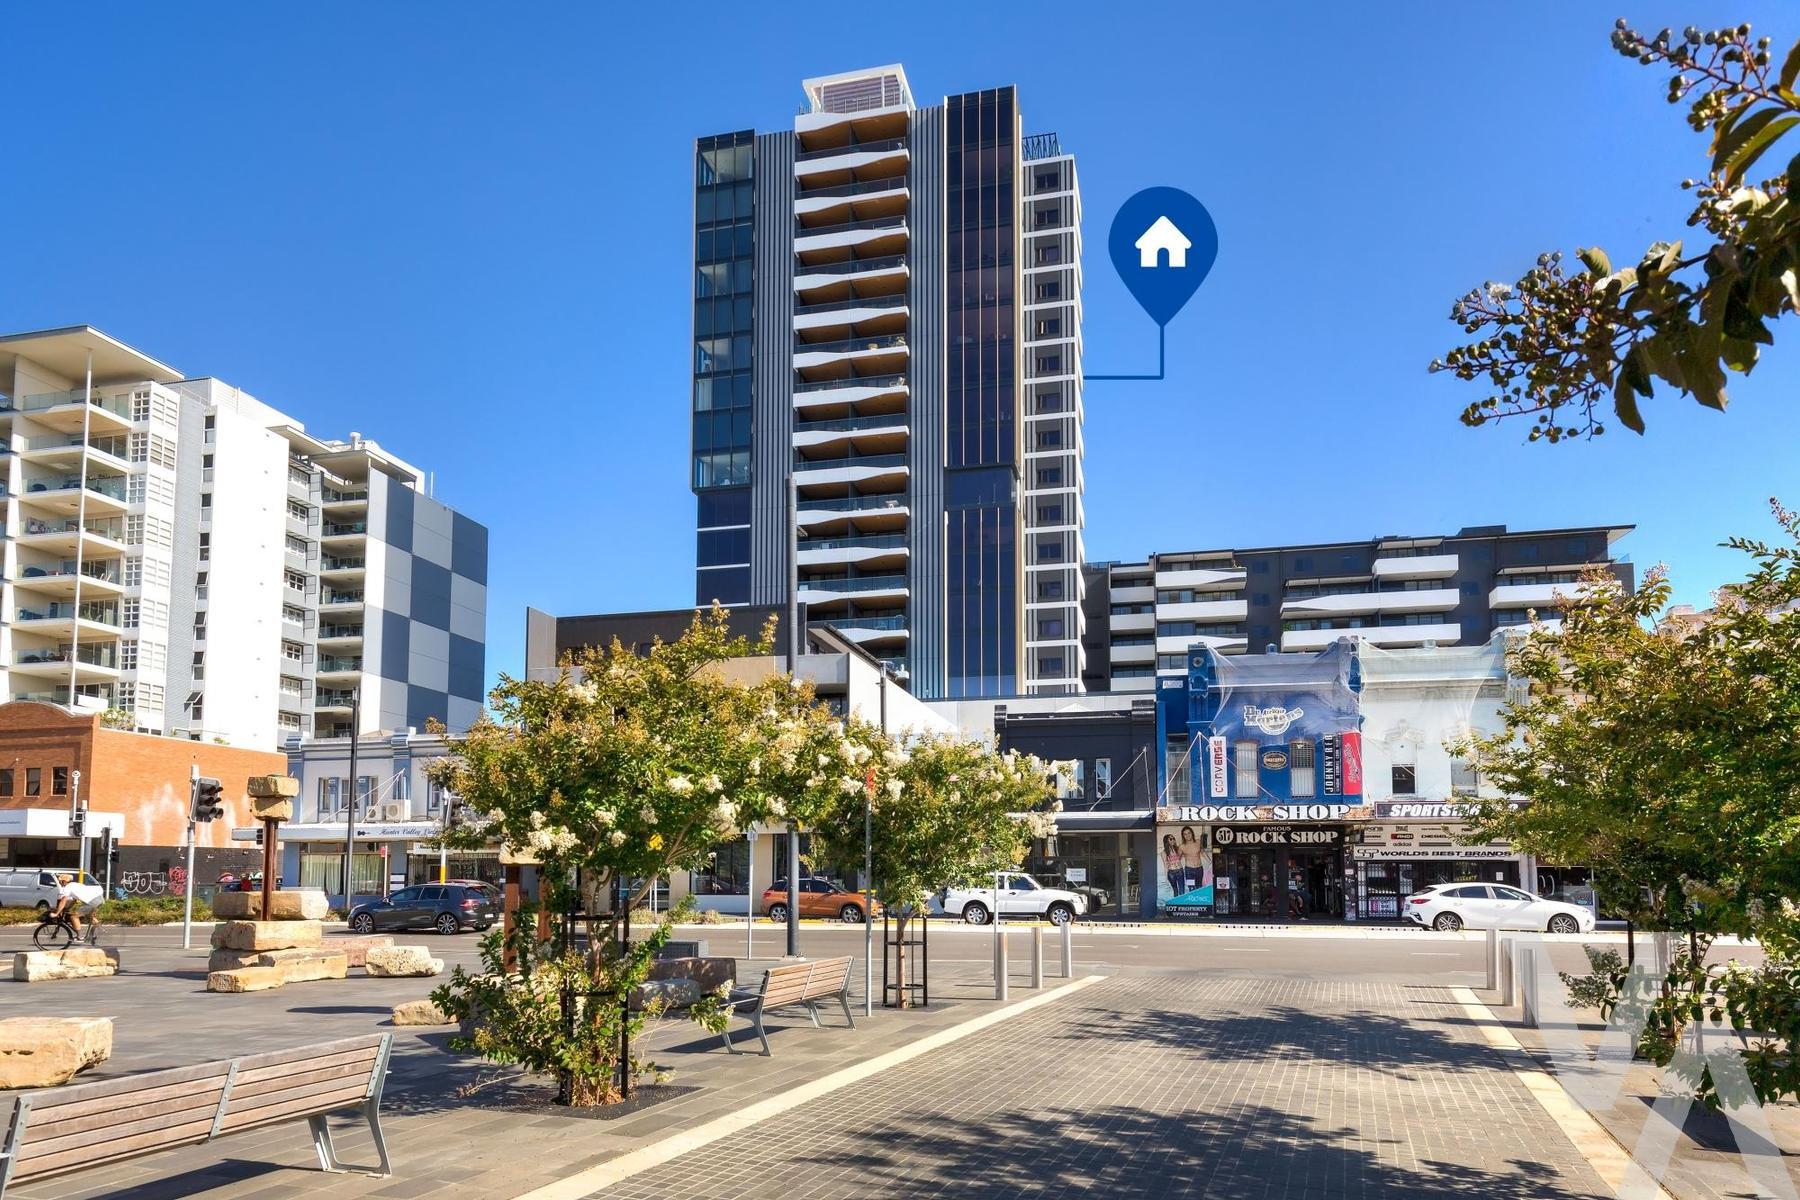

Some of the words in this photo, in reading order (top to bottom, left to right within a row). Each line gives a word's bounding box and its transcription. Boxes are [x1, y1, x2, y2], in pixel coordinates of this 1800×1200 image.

[1213, 740, 1224, 793] CONVERSE
[1325, 755, 1334, 793] JOHNNY
[1179, 805, 1258, 821] ROCK
[1273, 804, 1350, 820] SHOP
[1235, 832, 1288, 843] ROCK
[1290, 831, 1338, 843] SHOP
